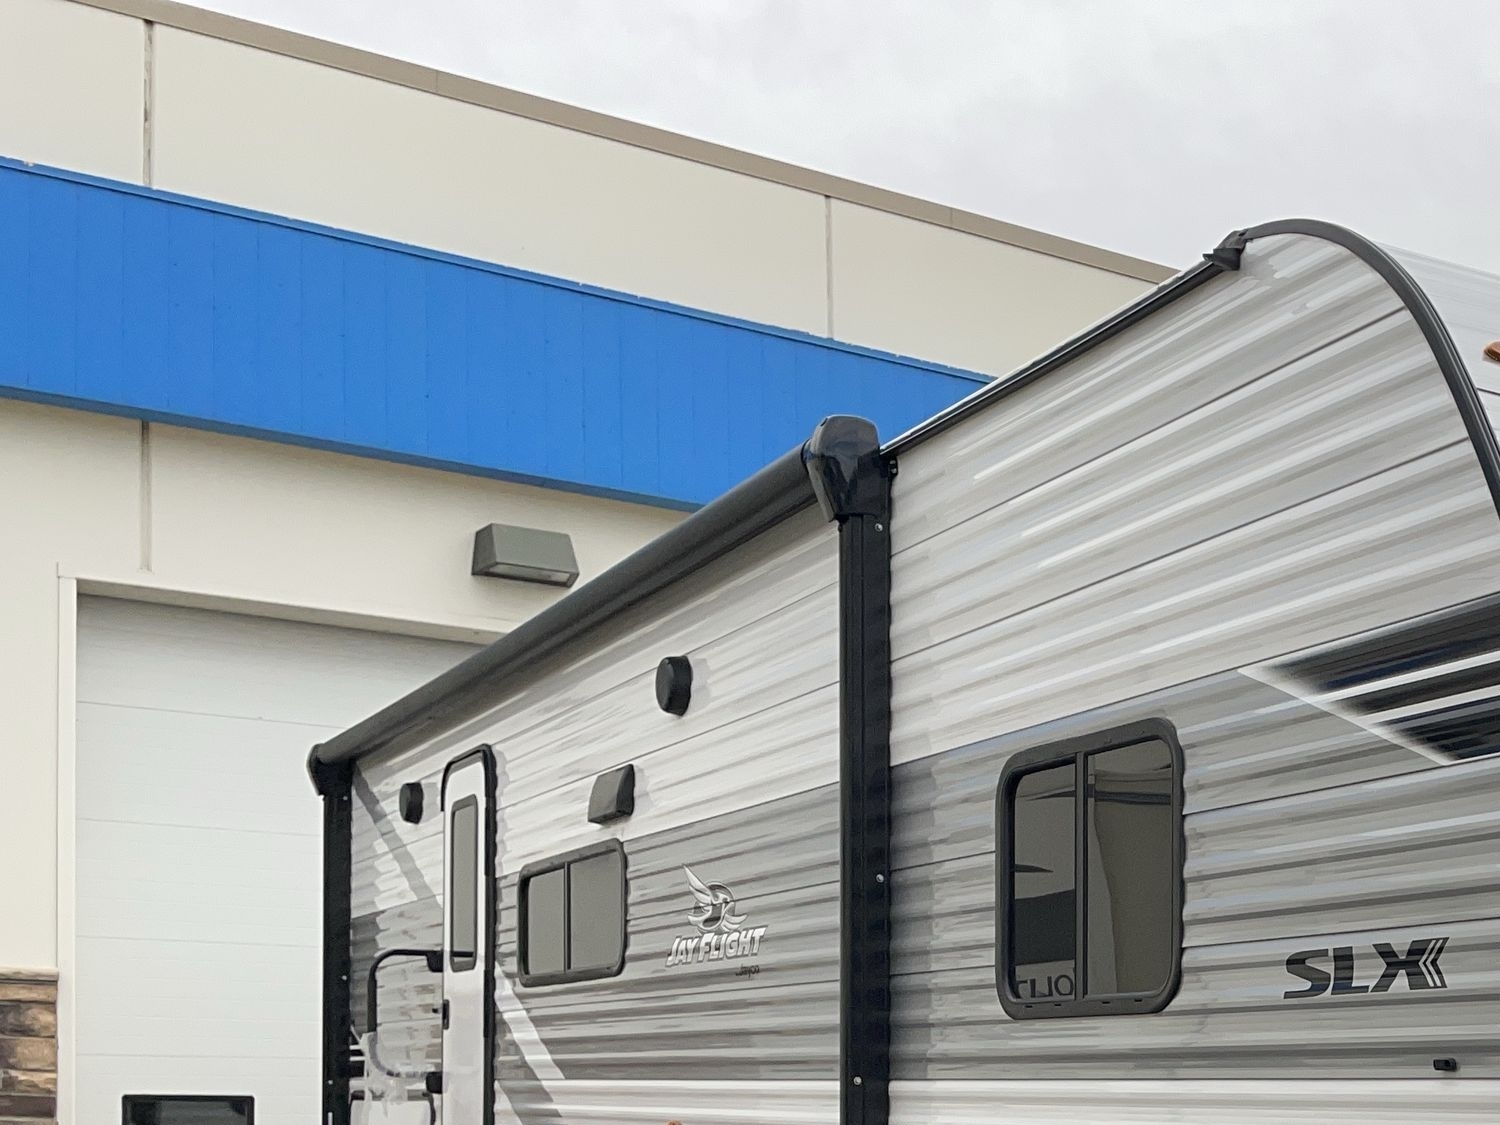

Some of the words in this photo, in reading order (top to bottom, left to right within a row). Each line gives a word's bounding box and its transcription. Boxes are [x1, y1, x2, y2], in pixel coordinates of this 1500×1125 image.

[664, 935, 701, 968] JAY
[697, 924, 768, 963] FLIGHT
[1283, 936, 1450, 1000] SLX
